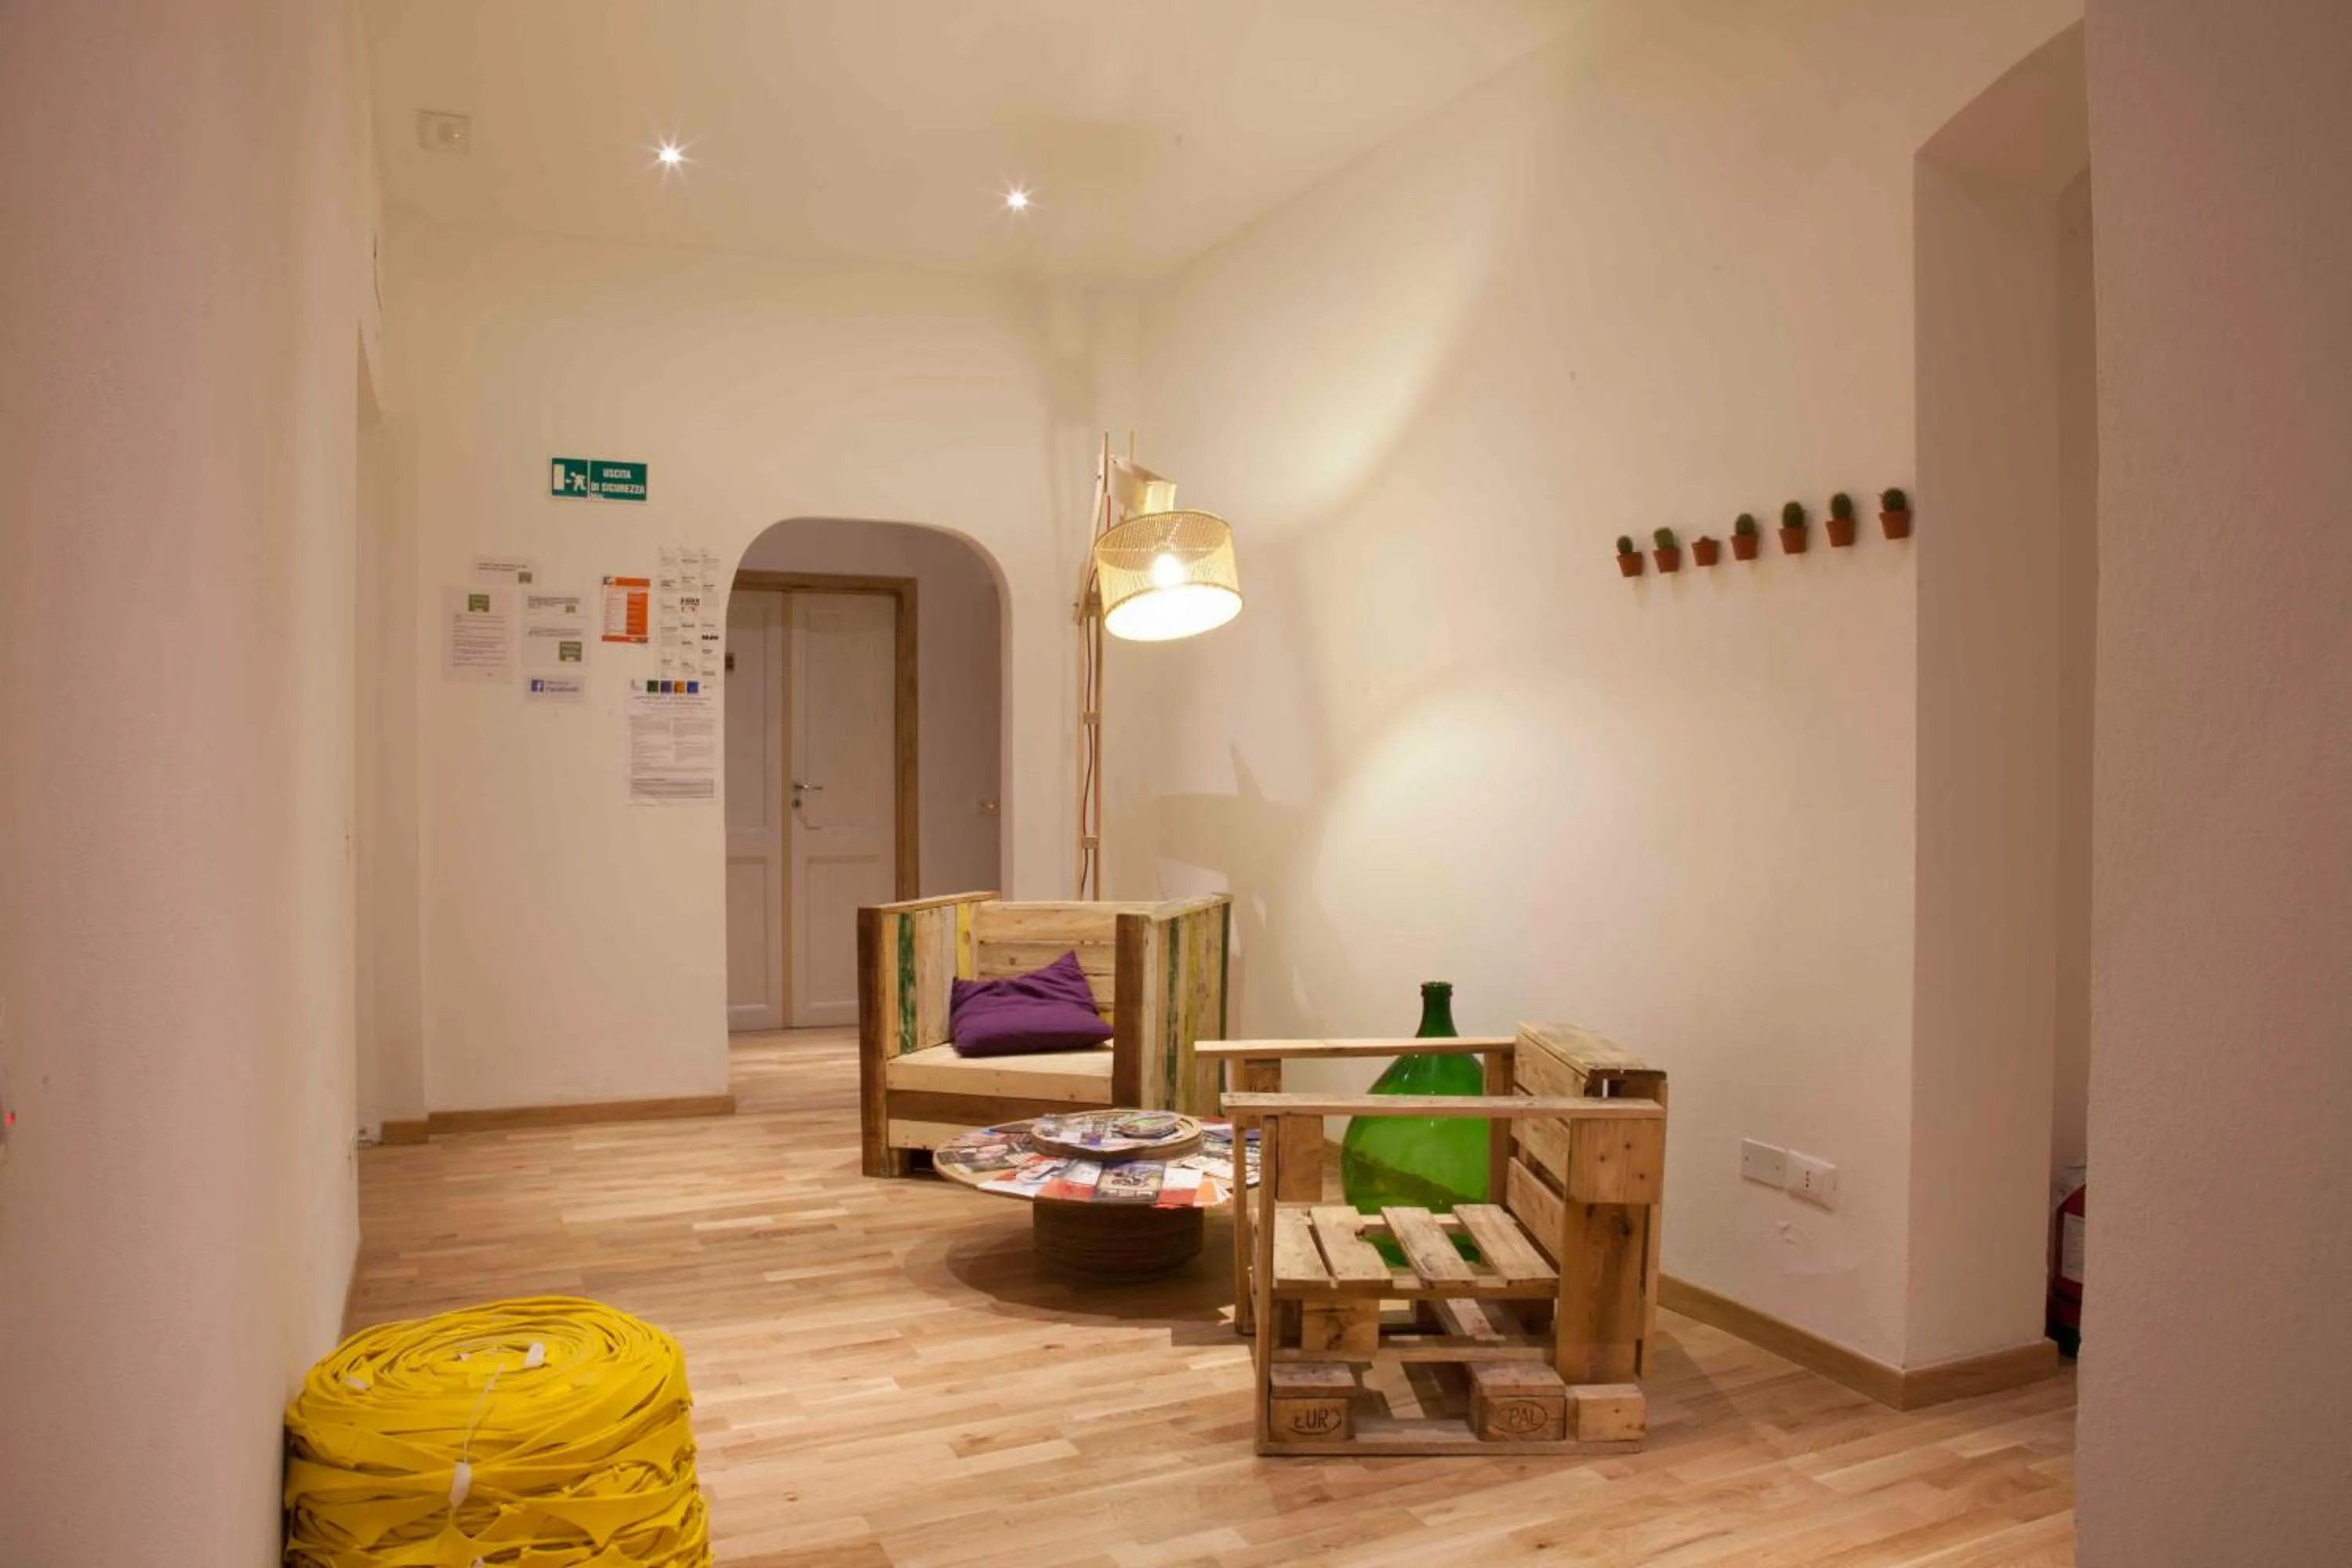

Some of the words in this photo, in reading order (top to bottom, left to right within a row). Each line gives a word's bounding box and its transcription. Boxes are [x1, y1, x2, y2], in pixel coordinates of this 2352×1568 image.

[602, 468, 631, 479] USCITA
[590, 481, 600, 492] DI
[1508, 1407, 1537, 1426] PAL
